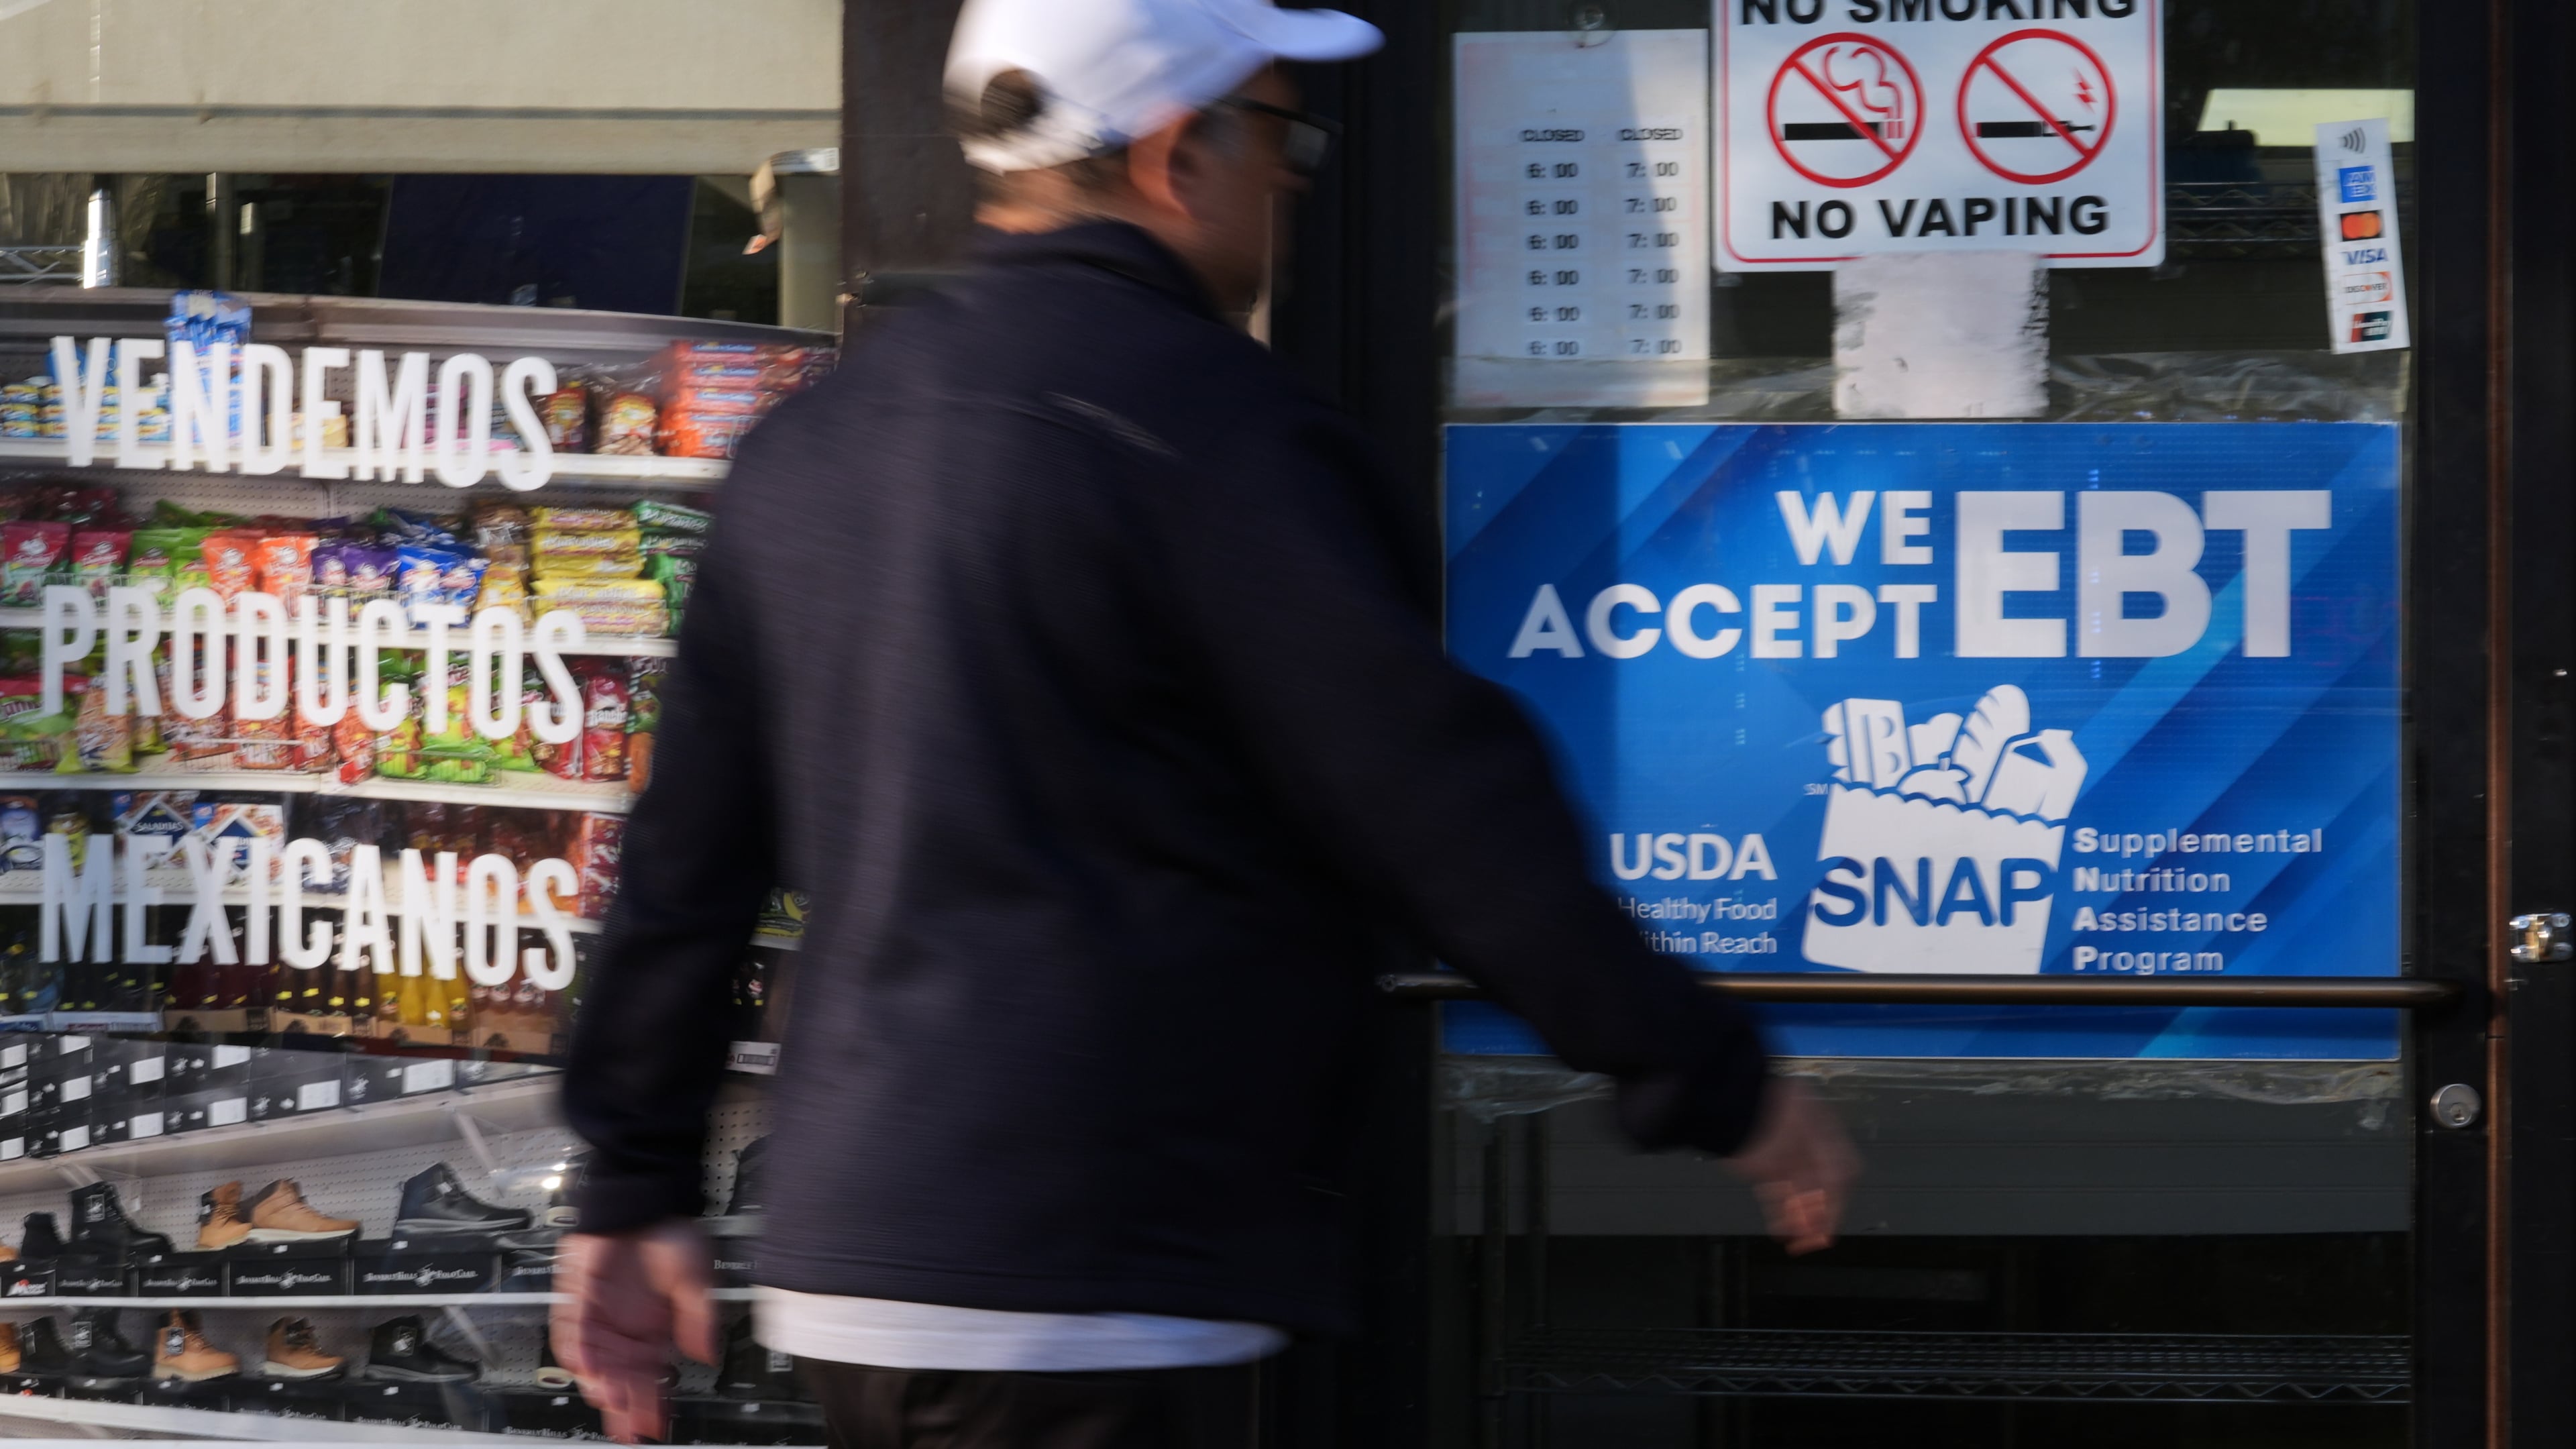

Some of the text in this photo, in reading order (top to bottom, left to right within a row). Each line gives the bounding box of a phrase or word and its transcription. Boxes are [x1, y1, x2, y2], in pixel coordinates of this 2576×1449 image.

[1741, 0, 1827, 25] NO
[1519, 128, 1683, 142] CLOSED CLOSED
[1770, 195, 2110, 239] NO VAPING
[2342, 248, 2389, 265] VISA
[50, 335, 557, 492] VENDEMOS
[1775, 490, 1934, 566] WE
[1953, 490, 2332, 659] EBT
[1506, 582, 1938, 659] ACCEPT
[38, 584, 586, 745] PRODUCTOS
[1803, 783, 1829, 796] SM
[1610, 833, 1778, 881] USDA
[2072, 827, 2322, 859] Supplemental
[1813, 856, 2057, 928] SNAP
[2072, 867, 2231, 892] Nutrition
[38, 833, 578, 991] MEXICANOS
[1713, 897, 1778, 920] Food
[2072, 906, 2268, 932] Assistance
[1639, 930, 1778, 954] ithin Reach
[2072, 946, 2224, 975] Program
